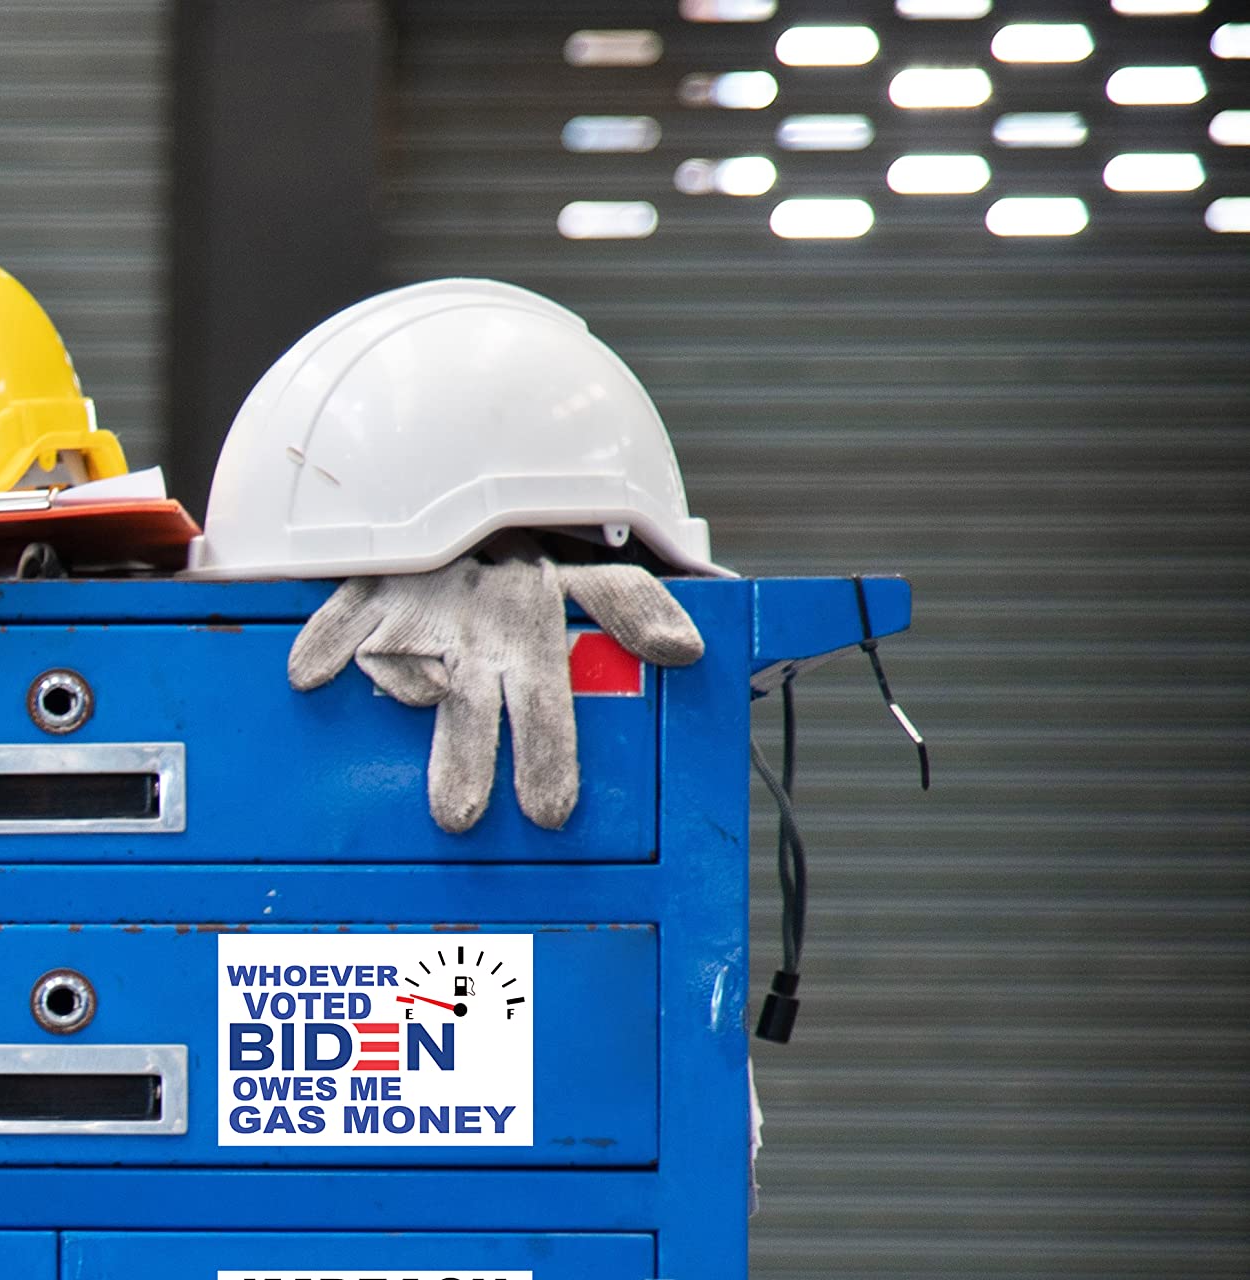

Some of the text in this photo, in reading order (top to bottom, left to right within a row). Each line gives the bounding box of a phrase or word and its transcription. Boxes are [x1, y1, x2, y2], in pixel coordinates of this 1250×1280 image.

[227, 965, 399, 987] WHOEVER
[243, 992, 372, 1020] VOTED
[405, 1008, 515, 1020] E F
[229, 1023, 455, 1071] BIDEN
[233, 1076, 402, 1101] OWES ME
[229, 1106, 517, 1134] GAS MONEY
